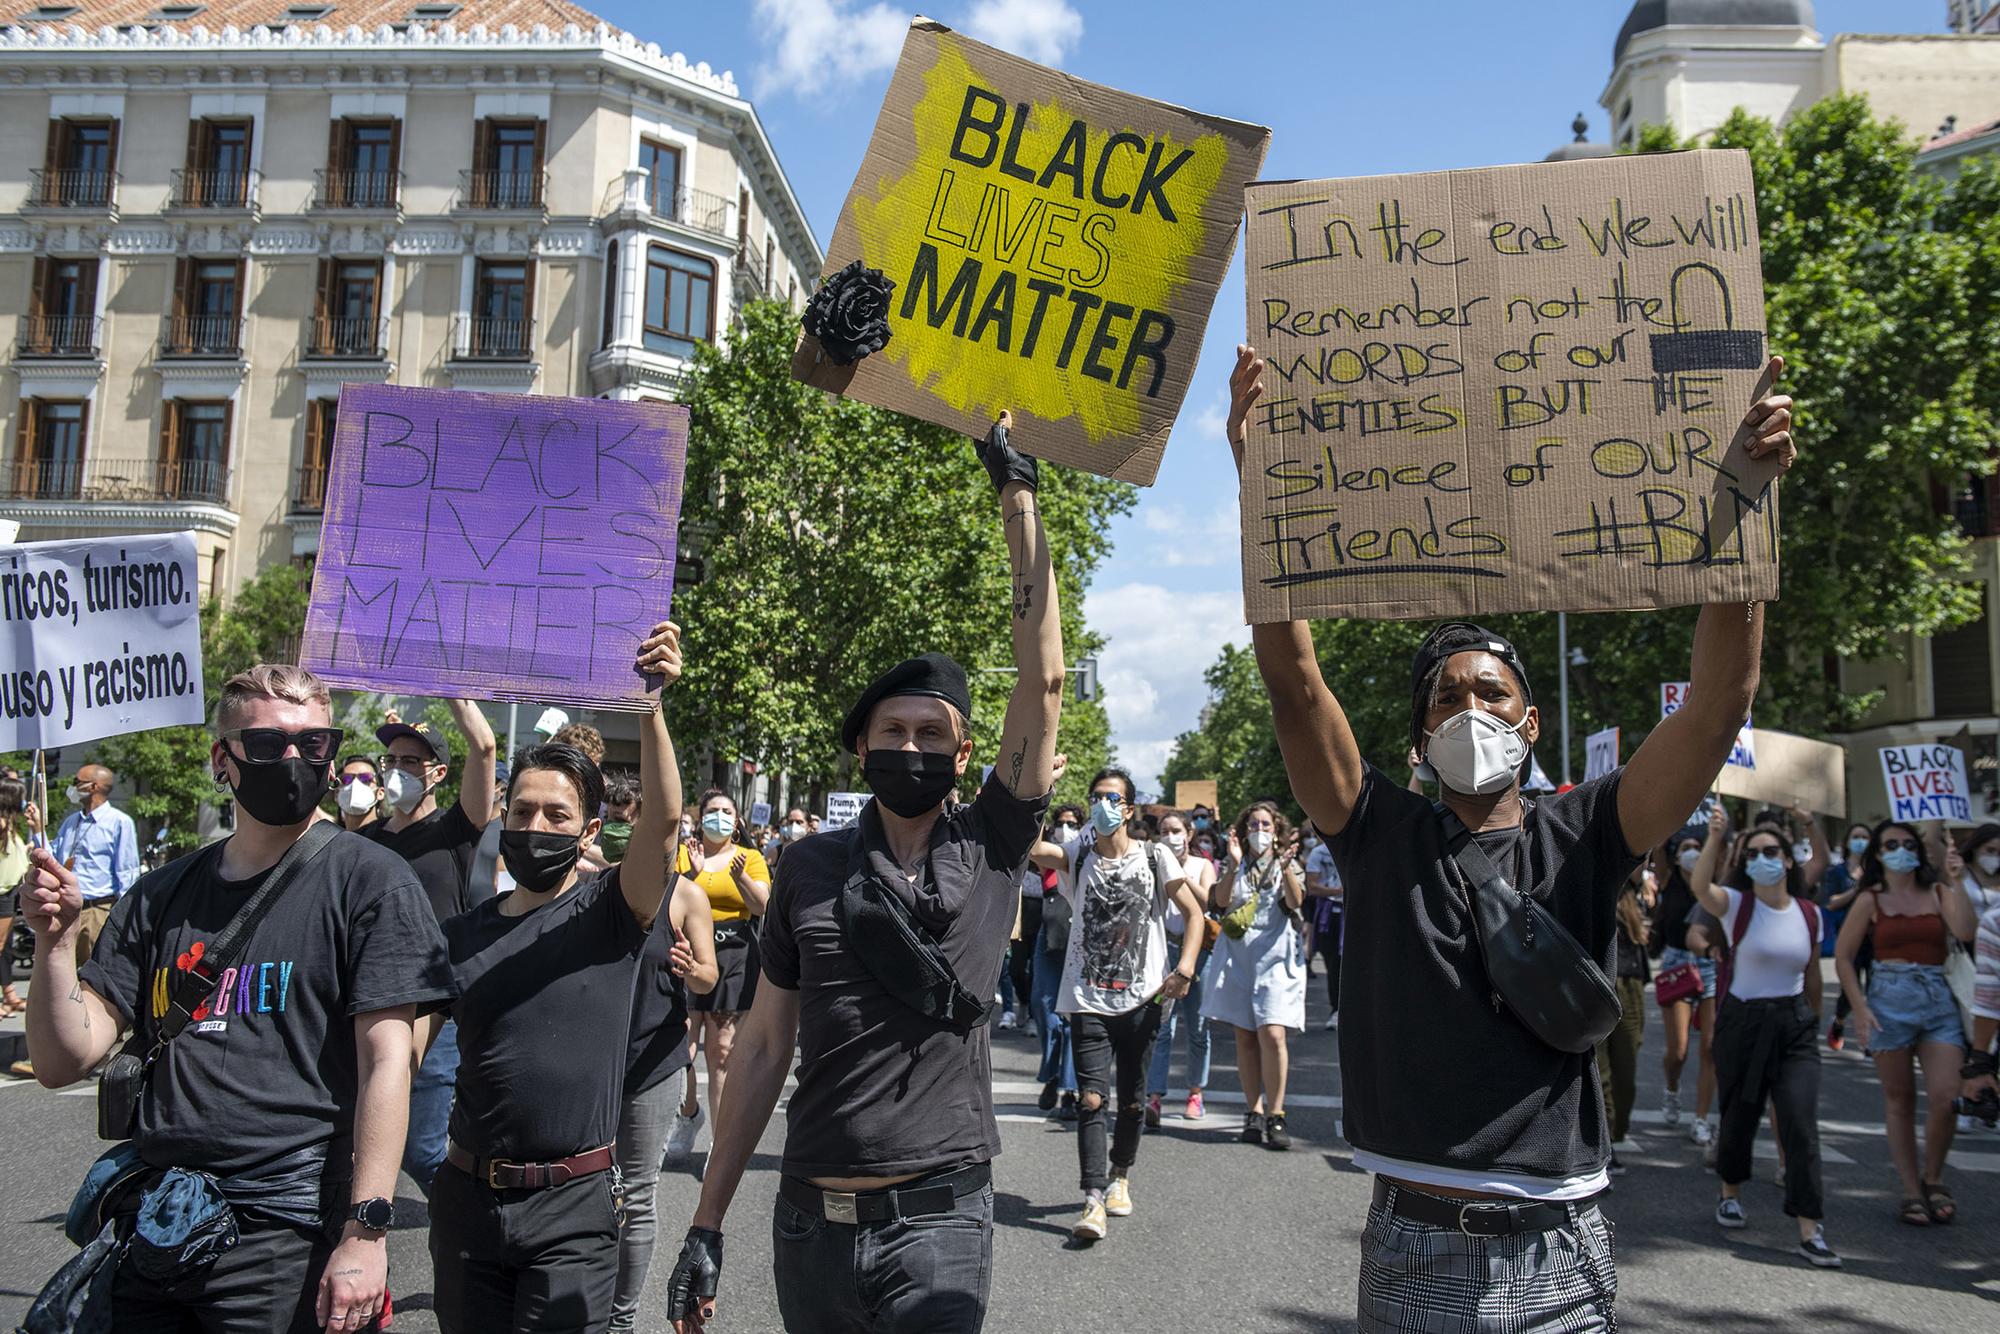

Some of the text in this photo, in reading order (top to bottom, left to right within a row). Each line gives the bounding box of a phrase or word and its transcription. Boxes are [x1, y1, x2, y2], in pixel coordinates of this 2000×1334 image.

[949, 85, 1195, 223] BLACK
[924, 169, 1116, 288] LIVES
[1258, 200, 1363, 271] In
[1369, 199, 1469, 265] the
[1487, 204, 1568, 255] end
[899, 241, 1175, 398] MATTER
[1262, 261, 1692, 338] Remember not the
[1266, 328, 1636, 387] WORDS of our
[1498, 379, 1602, 431] BUT
[1623, 371, 1723, 416] THE
[359, 411, 662, 511] BLACK
[1265, 427, 1739, 500] Silence of OUR
[347, 488, 666, 580] LIVES
[1260, 480, 1777, 577] Friends #BLM
[2, 549, 191, 627] ricos, turismo.
[331, 575, 647, 681] MATTER
[0, 642, 195, 730] uso y racismo.
[1884, 747, 1958, 774] BLACK
[1891, 771, 1955, 798] LIVES
[1896, 794, 1972, 823] MATTER
[152, 961, 294, 1018] MCKEY
